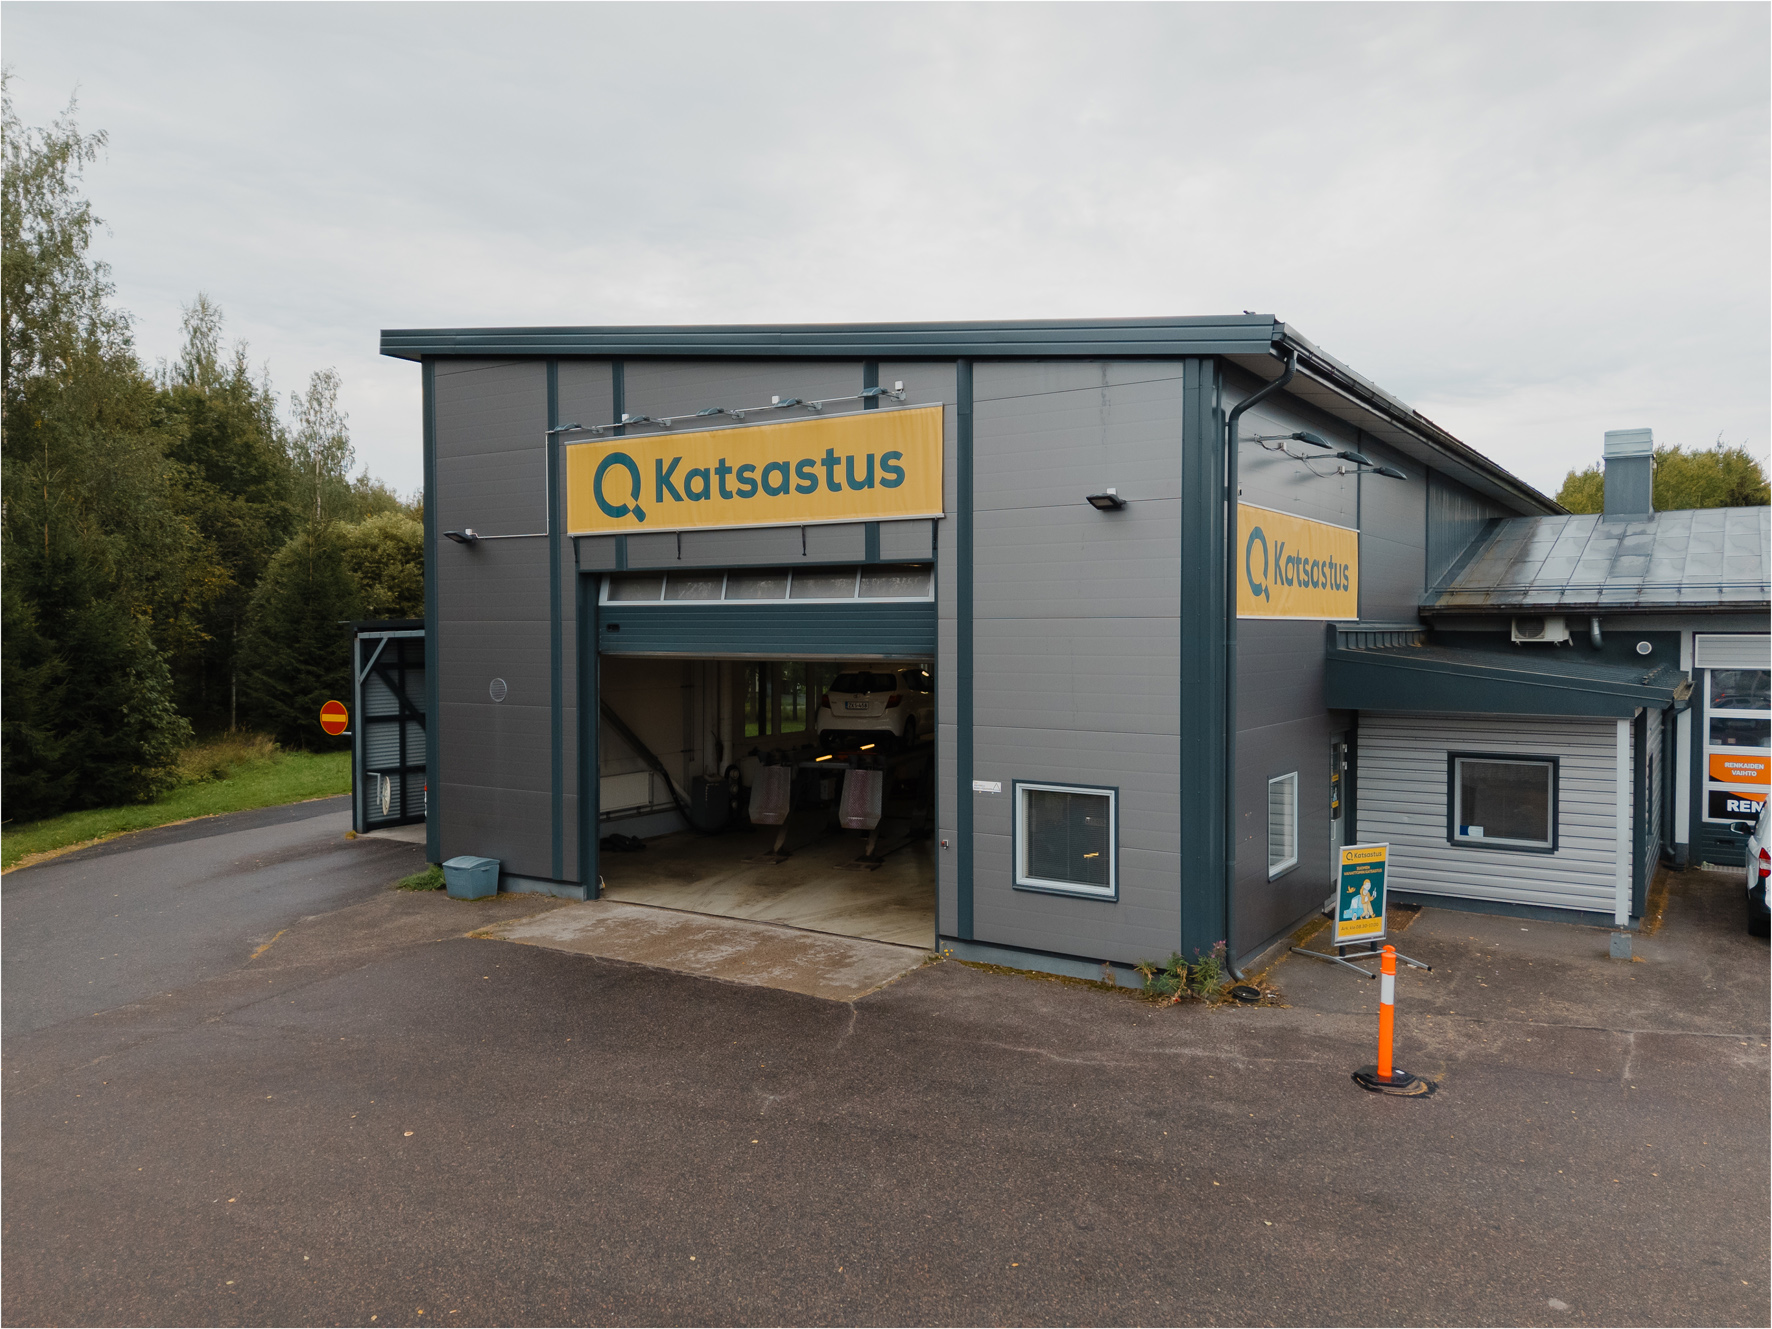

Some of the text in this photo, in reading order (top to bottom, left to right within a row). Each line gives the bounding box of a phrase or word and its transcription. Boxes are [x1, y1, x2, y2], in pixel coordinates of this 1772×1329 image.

[655, 448, 906, 503] Katsastus
[1274, 540, 1349, 592] Katsastus
[1724, 762, 1764, 770] RENKAIDEN
[1354, 851, 1382, 859] Katsastus
